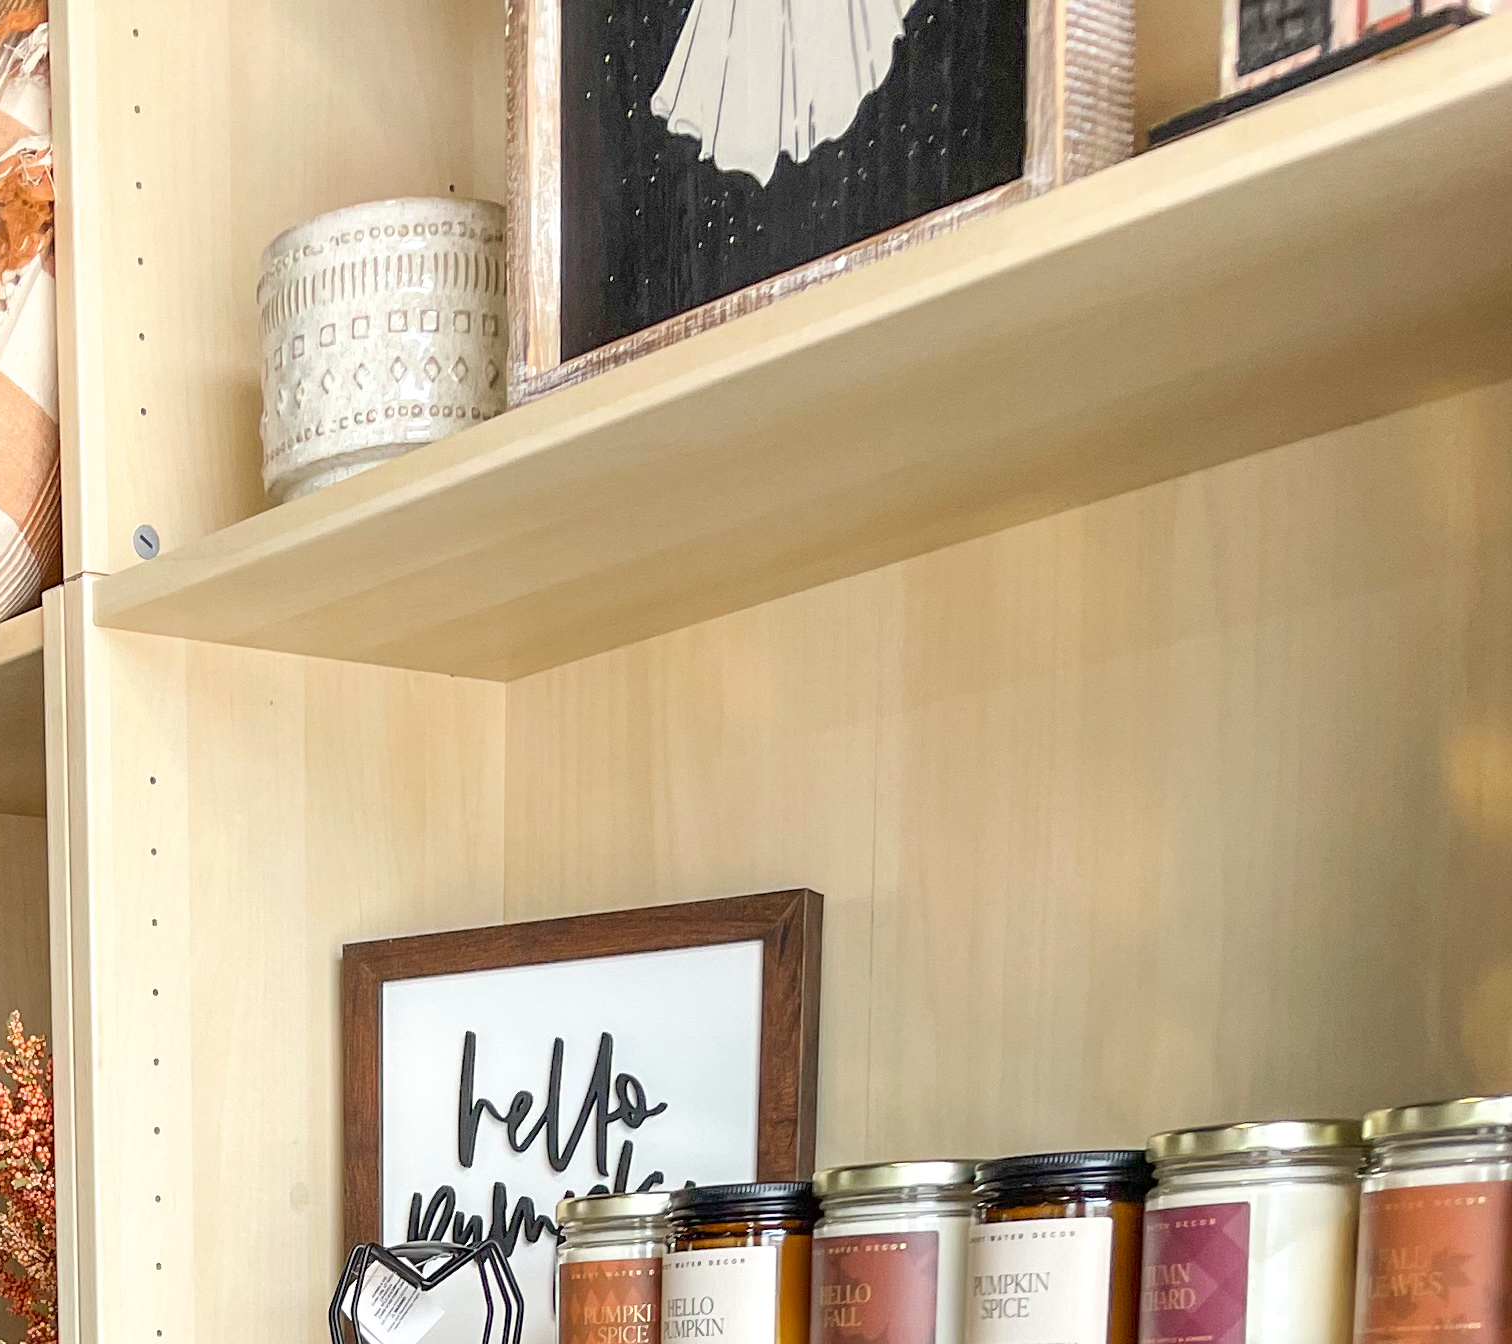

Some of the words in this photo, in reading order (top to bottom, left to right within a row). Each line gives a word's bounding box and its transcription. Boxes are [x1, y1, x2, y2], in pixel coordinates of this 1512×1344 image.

[458, 1030, 669, 1178] hello
[709, 1258, 746, 1267] DECOR
[821, 1283, 872, 1306] HELLO
[972, 1271, 1051, 1298] PUMPKIN
[667, 1296, 715, 1318] HELLO
[823, 1306, 863, 1329] FALL
[980, 1297, 1031, 1320] SPICE
[597, 1325, 650, 1344] SPICE
[663, 1317, 725, 1340] PUMPKIN
